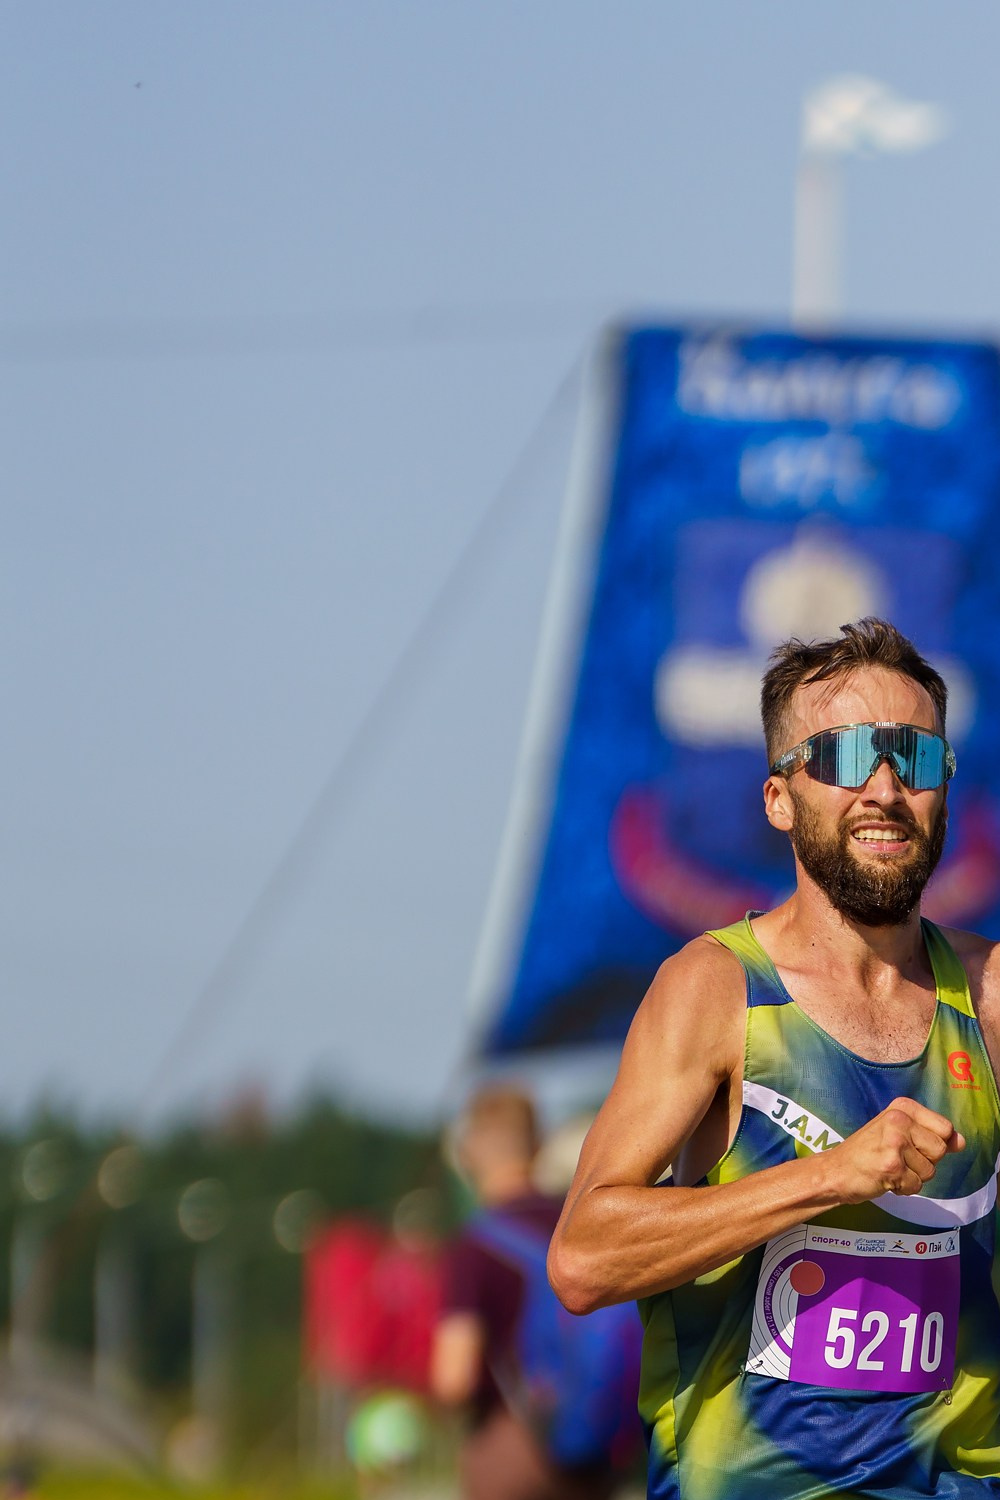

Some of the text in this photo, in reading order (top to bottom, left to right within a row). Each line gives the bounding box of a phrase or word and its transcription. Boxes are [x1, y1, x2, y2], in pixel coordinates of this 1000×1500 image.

[811, 1236, 839, 1245] СПОРТ
[928, 1241, 942, 1253] Пэй
[824, 1307, 944, 1372] 5210
